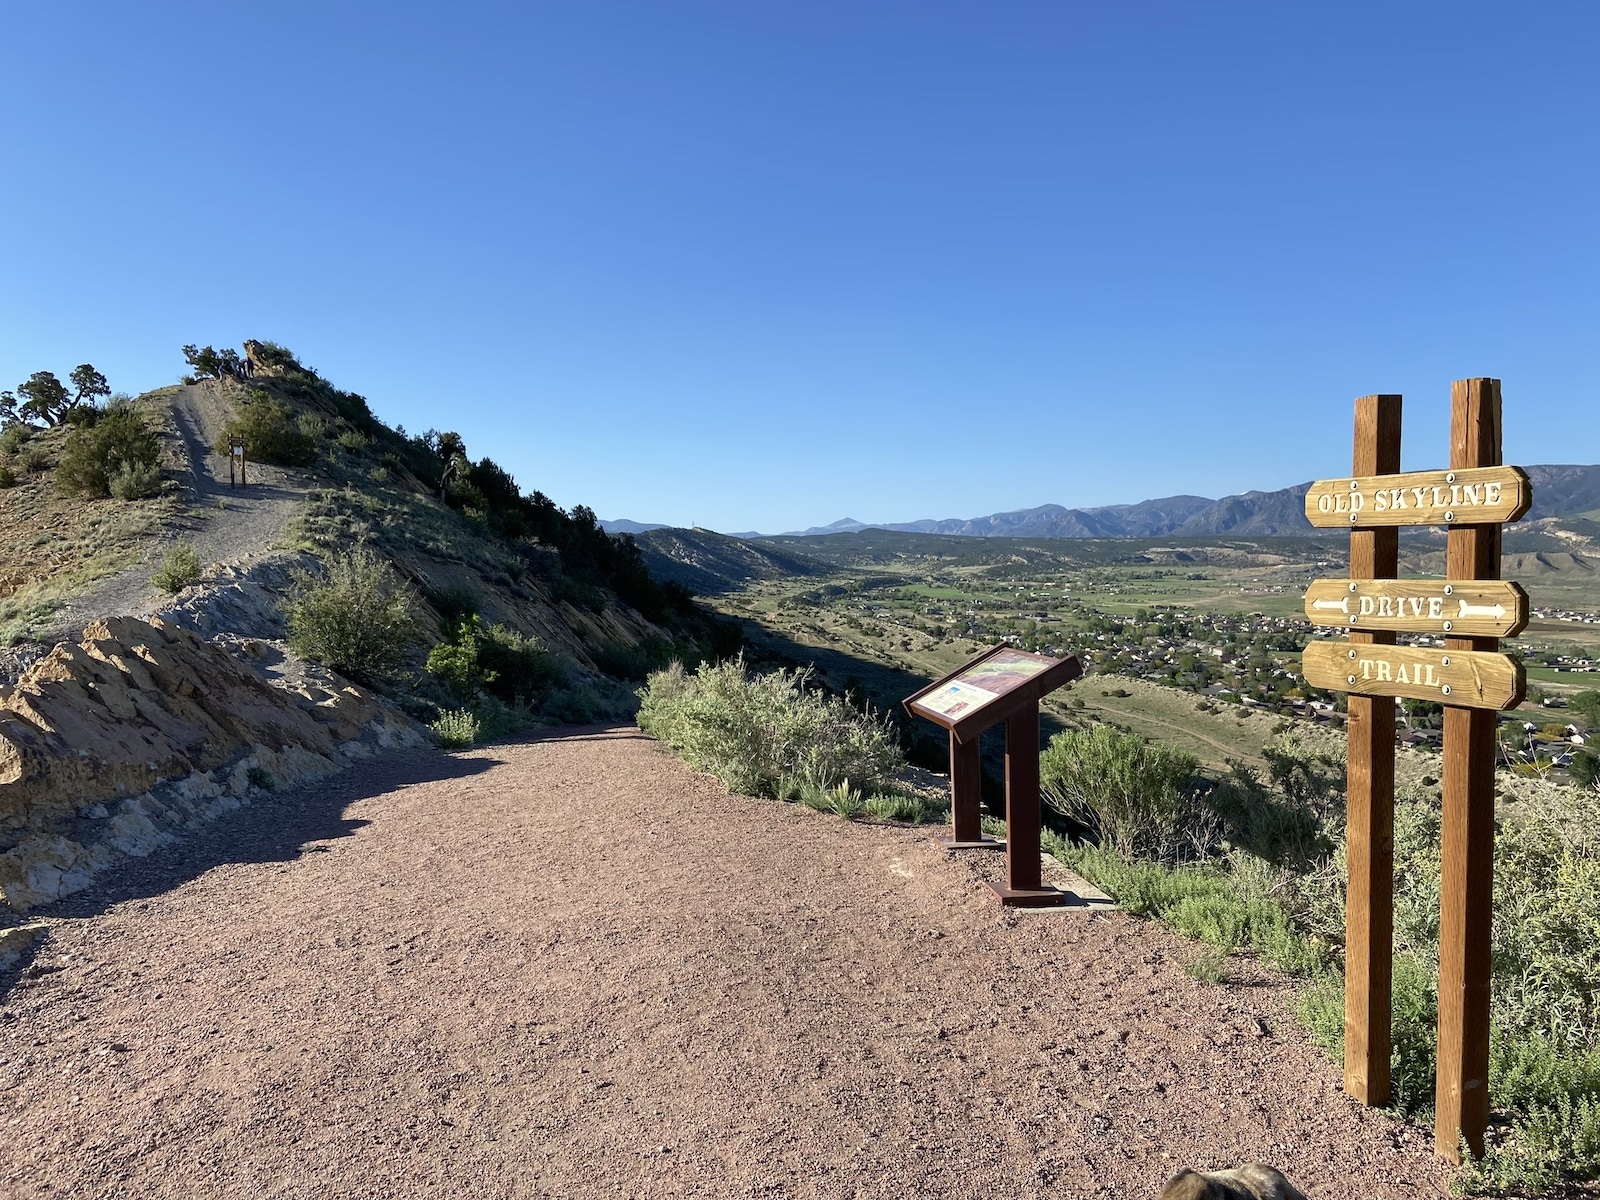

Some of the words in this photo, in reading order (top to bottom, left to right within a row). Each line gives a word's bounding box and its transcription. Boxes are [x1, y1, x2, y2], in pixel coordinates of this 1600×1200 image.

[1318, 491, 1364, 513] OLD
[1374, 482, 1501, 512] SKYLINE
[1359, 596, 1443, 619] DRIVE
[1358, 659, 1440, 687] TRAIL
